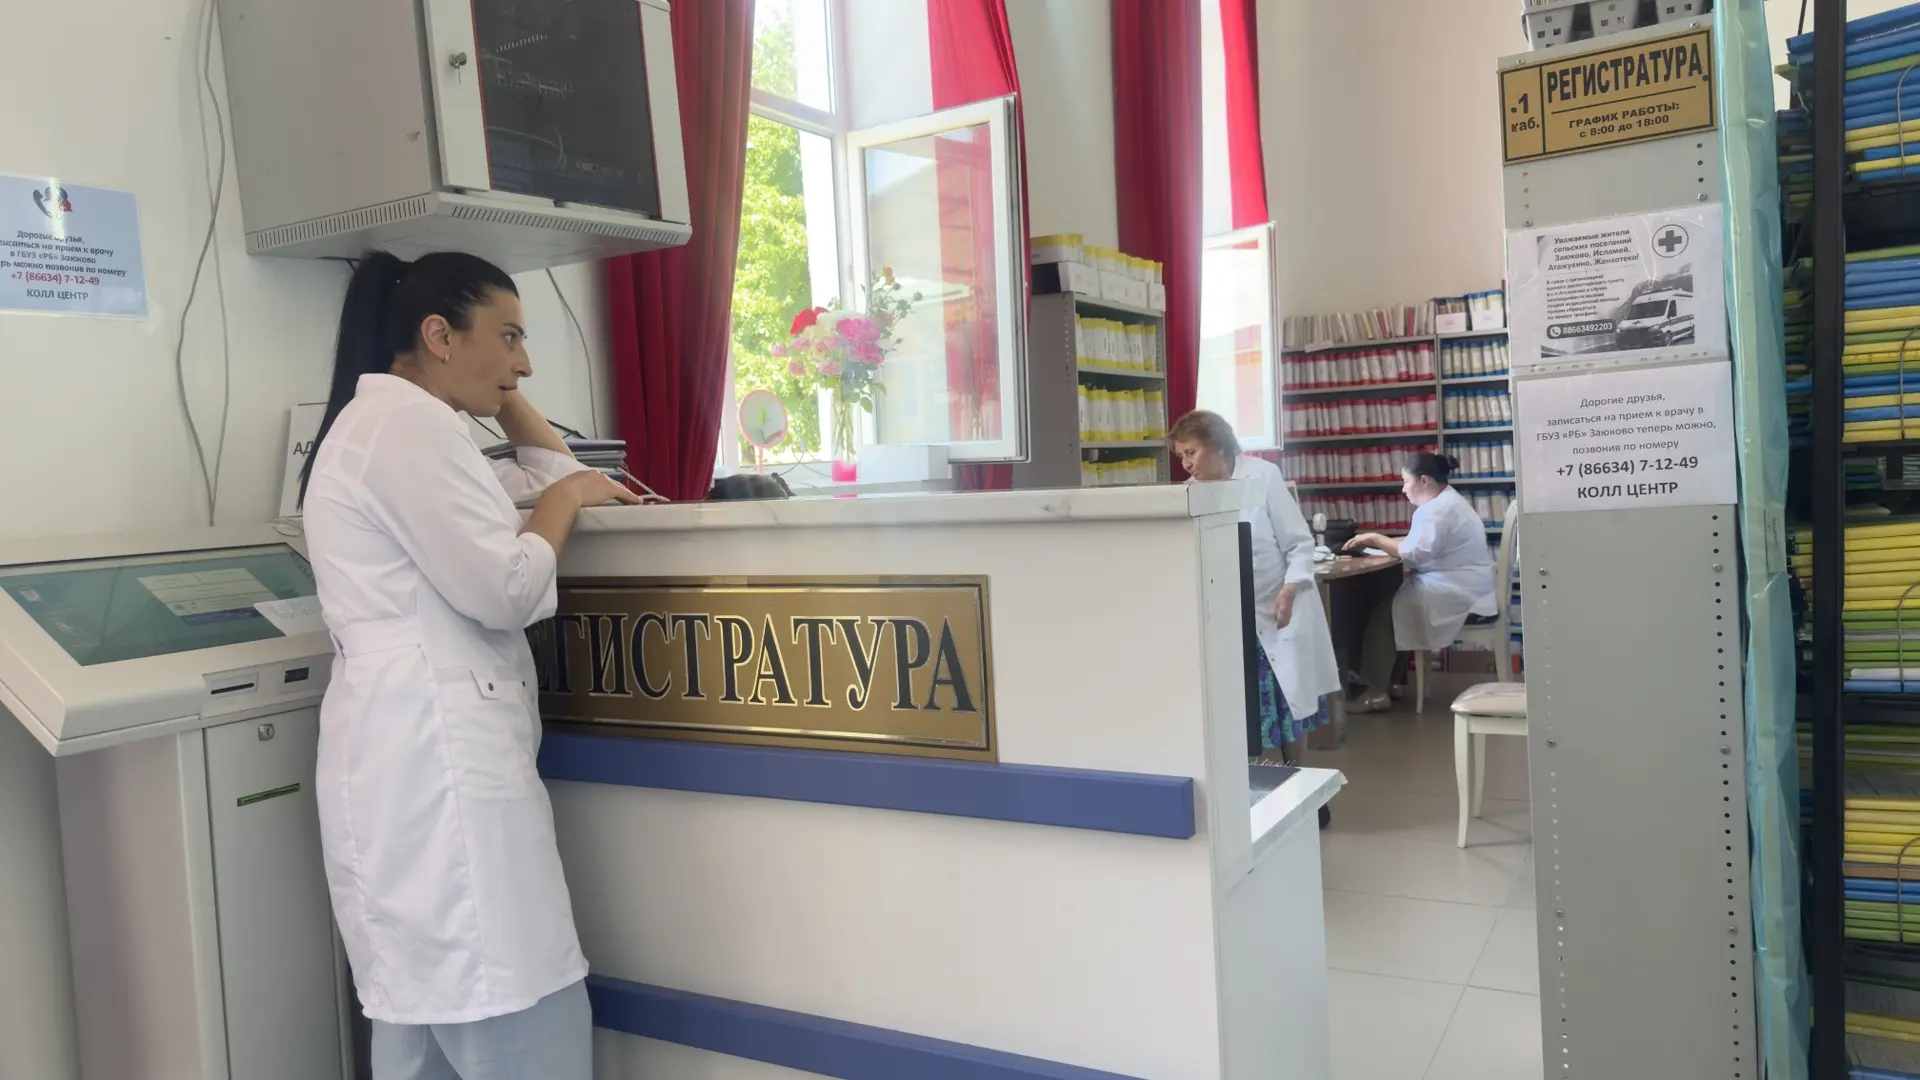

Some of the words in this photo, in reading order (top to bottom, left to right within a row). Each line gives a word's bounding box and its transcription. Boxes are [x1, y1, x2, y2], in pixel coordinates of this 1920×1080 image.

[1547, 42, 1703, 104] РЕГИСТРАТУРА
[1569, 112, 1619, 129] ГРАФИК
[1622, 102, 1680, 120] РАБОТЫ:
[1511, 117, 1540, 133] каб.
[1579, 130, 1587, 138] с
[1590, 124, 1615, 137] 8:00
[1618, 122, 1633, 133] до
[1636, 114, 1669, 128] 18:00
[54, 235, 85, 244] узья,
[1553, 244, 1588, 253] сельских
[1590, 237, 1632, 249] поселений
[1554, 233, 1599, 245] Уважаемые
[1601, 229, 1630, 238] жители
[17, 251, 36, 259] ГБУЗ
[60, 254, 96, 263] Заюково
[90, 248, 114, 257] врачу
[1555, 252, 1591, 262] Заюково,
[13, 261, 43, 269] можно
[45, 263, 85, 273] позвонив
[97, 267, 127, 277] номеру
[1548, 260, 1592, 271] Атажукино,
[1594, 253, 1639, 265] Жанхотеко!
[11, 272, 22, 280] +7
[26, 271, 62, 284] (86634)
[64, 275, 100, 285] 7-12-49
[26, 289, 54, 298] КОЛЛ
[57, 291, 88, 300] ЦЕНТР
[1562, 322, 1613, 335] 88663492203
[1580, 396, 1624, 408] Дорогие
[1626, 392, 1666, 405] друзья,
[1546, 413, 1601, 427] записаться
[1604, 412, 1616, 422] на
[1619, 410, 1653, 422] прием
[1655, 409, 1662, 417] к
[1664, 407, 1695, 419] врачу
[1697, 406, 1704, 414] в
[1536, 431, 1560, 441] ГБУЗ
[1562, 429, 1587, 439] «РБ»
[1589, 425, 1634, 438] Заюково
[1636, 423, 1673, 436] теперь
[1675, 420, 1717, 431] можно,
[1572, 443, 1620, 455] позвонив
[1624, 442, 1637, 451] по
[1639, 440, 1679, 452] номеру
[1556, 464, 1574, 477] +7
[1578, 459, 1635, 478] (86634)
[1639, 455, 1699, 472] 7-12-49
[1577, 485, 1622, 499] КОЛЛ
[1627, 481, 1678, 498] ЦЕНТР
[524, 611, 978, 712] ЕГИСТРАТУРА
